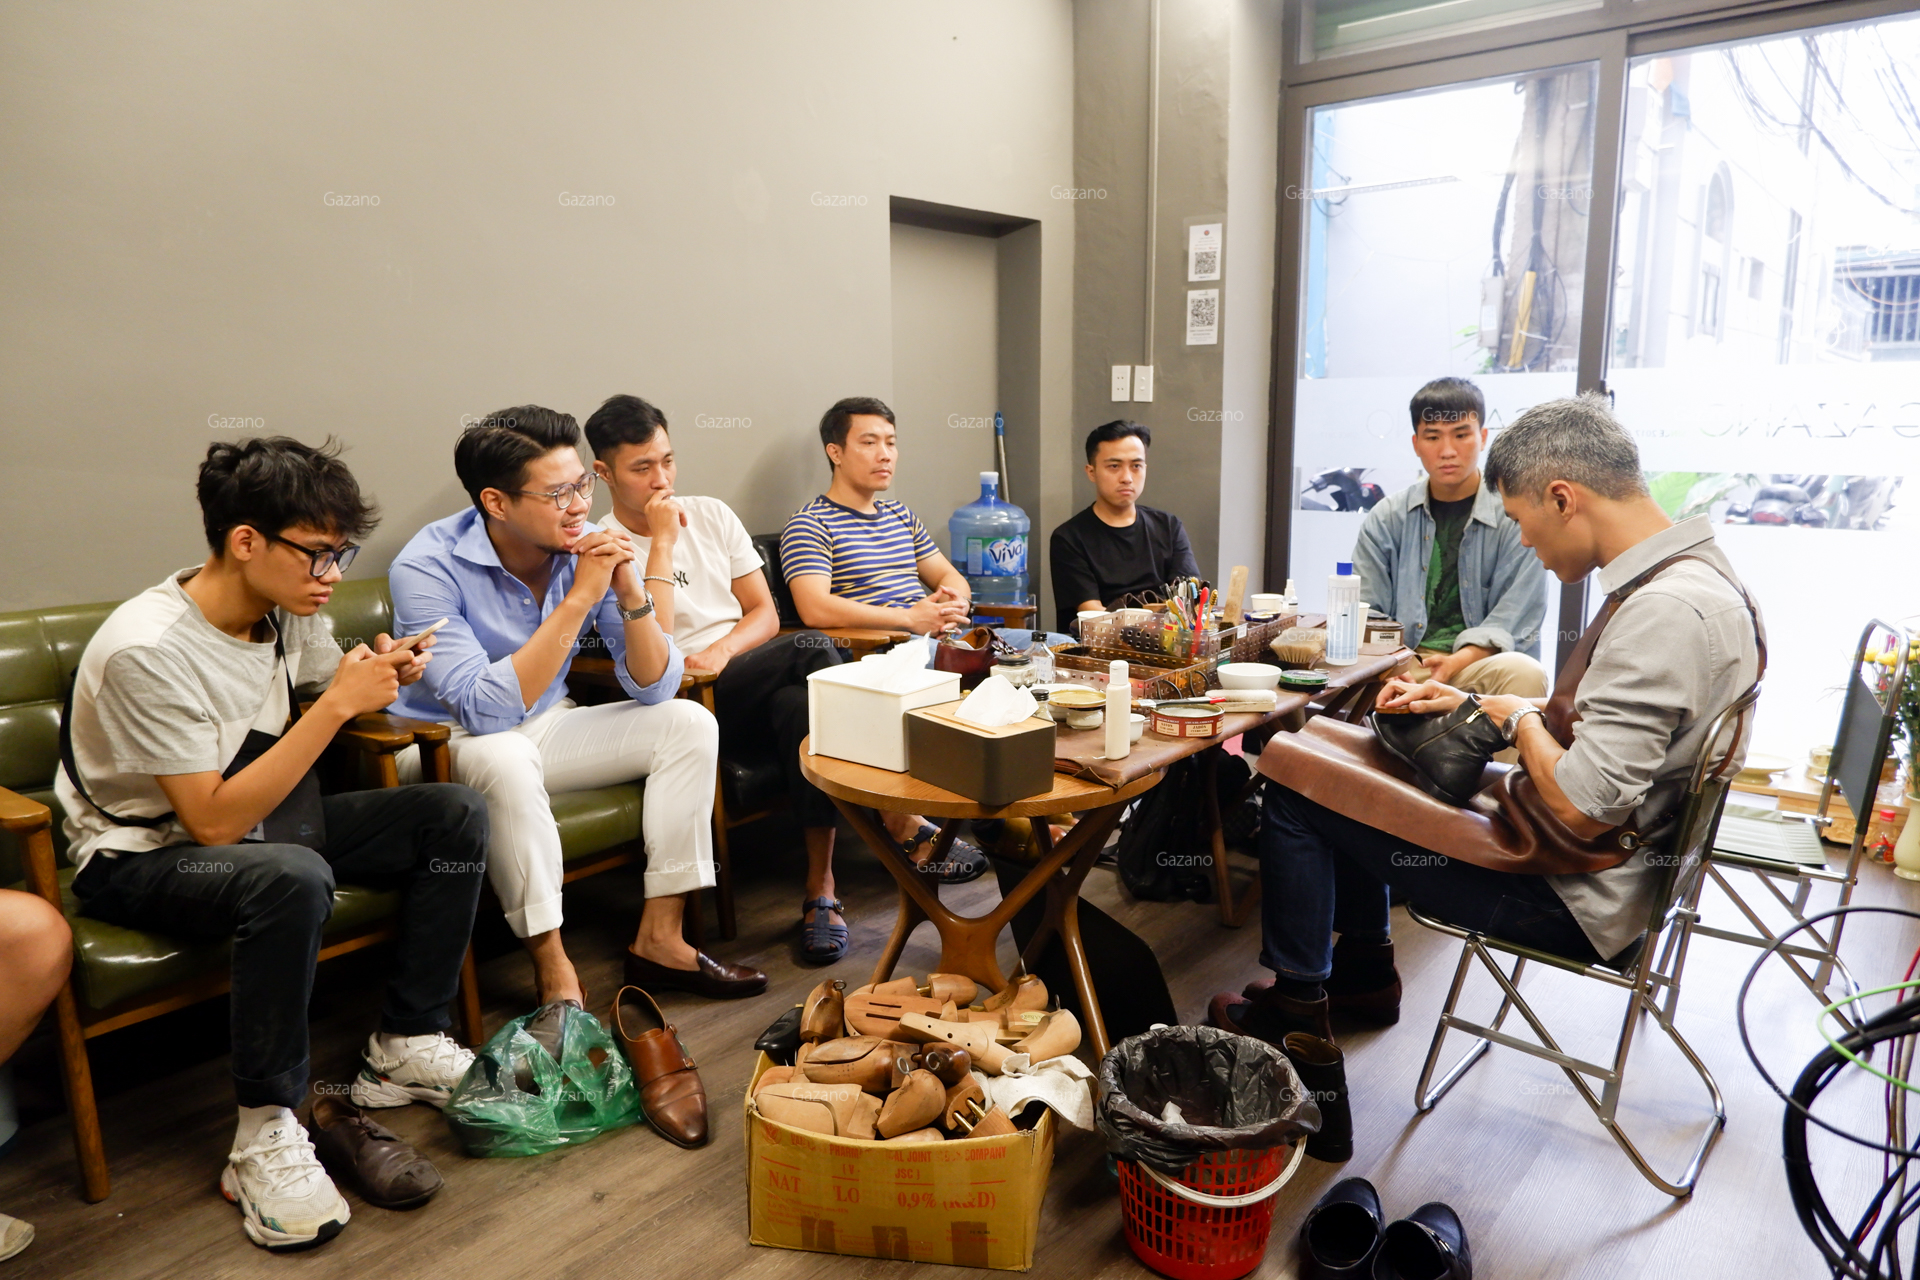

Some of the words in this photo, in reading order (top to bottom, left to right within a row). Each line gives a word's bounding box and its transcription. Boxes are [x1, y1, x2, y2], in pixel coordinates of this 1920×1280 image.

[906, 1150, 932, 1163] JOINT
[964, 1146, 1007, 1162] COMPANY
[897, 1191, 937, 1211] 0,9%
